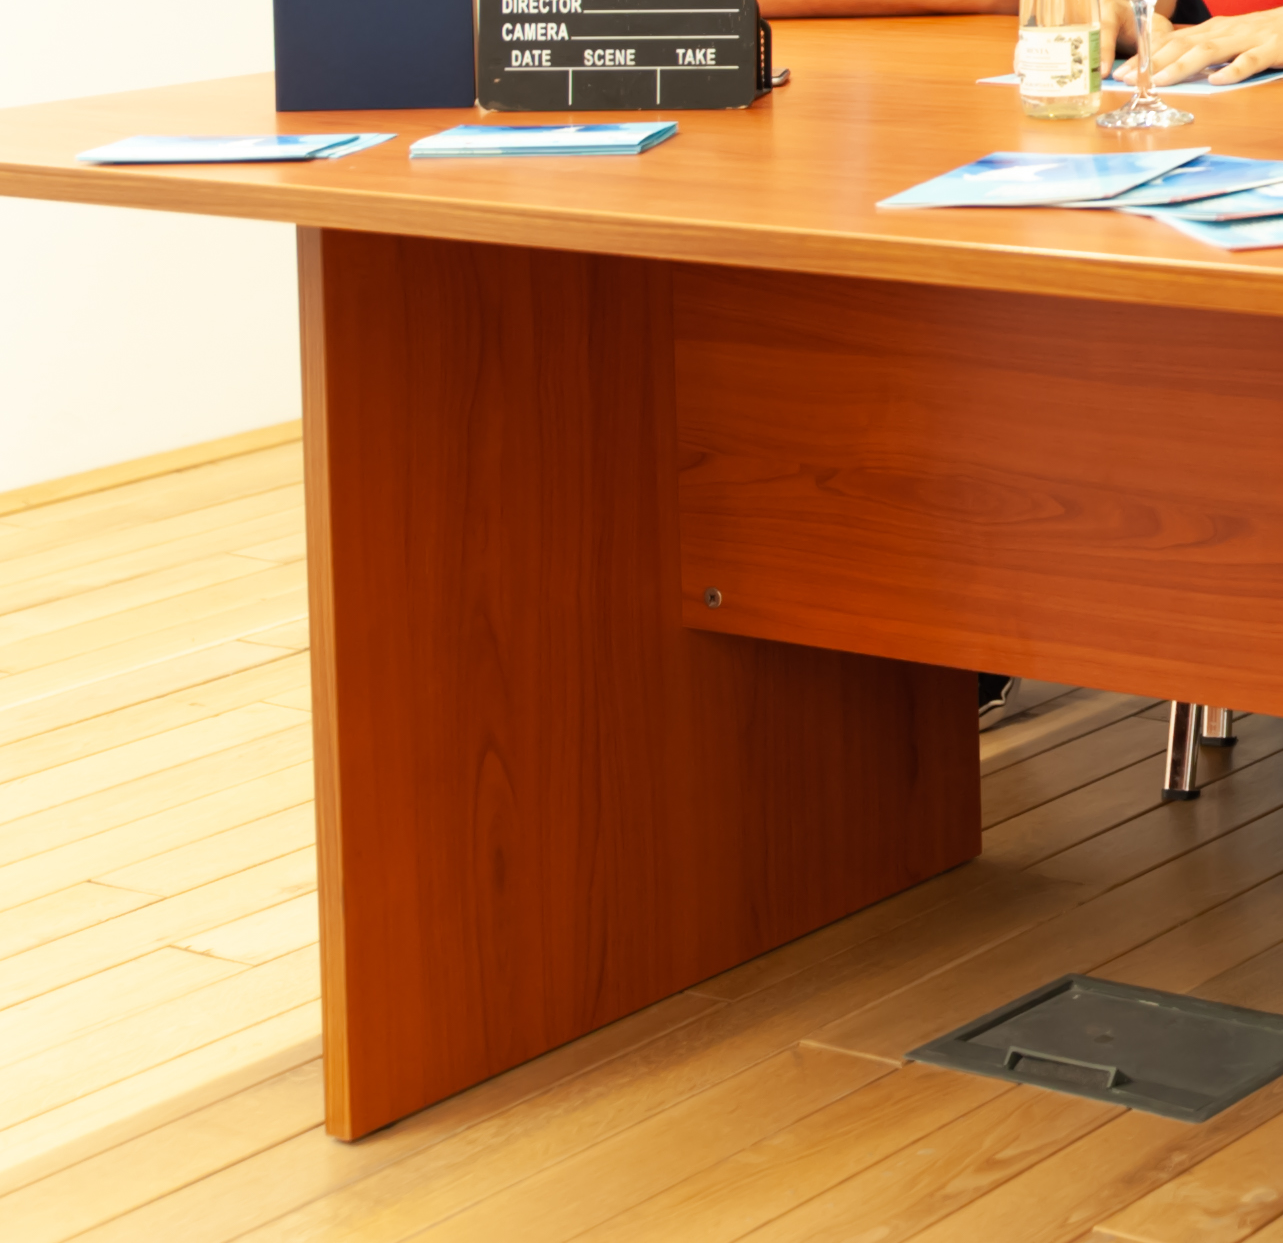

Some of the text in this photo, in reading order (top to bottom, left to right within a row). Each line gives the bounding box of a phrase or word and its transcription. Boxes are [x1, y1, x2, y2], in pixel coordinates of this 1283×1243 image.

[502, 23, 569, 41] CAMERA
[511, 48, 716, 66] DATE SCENE TAKE
